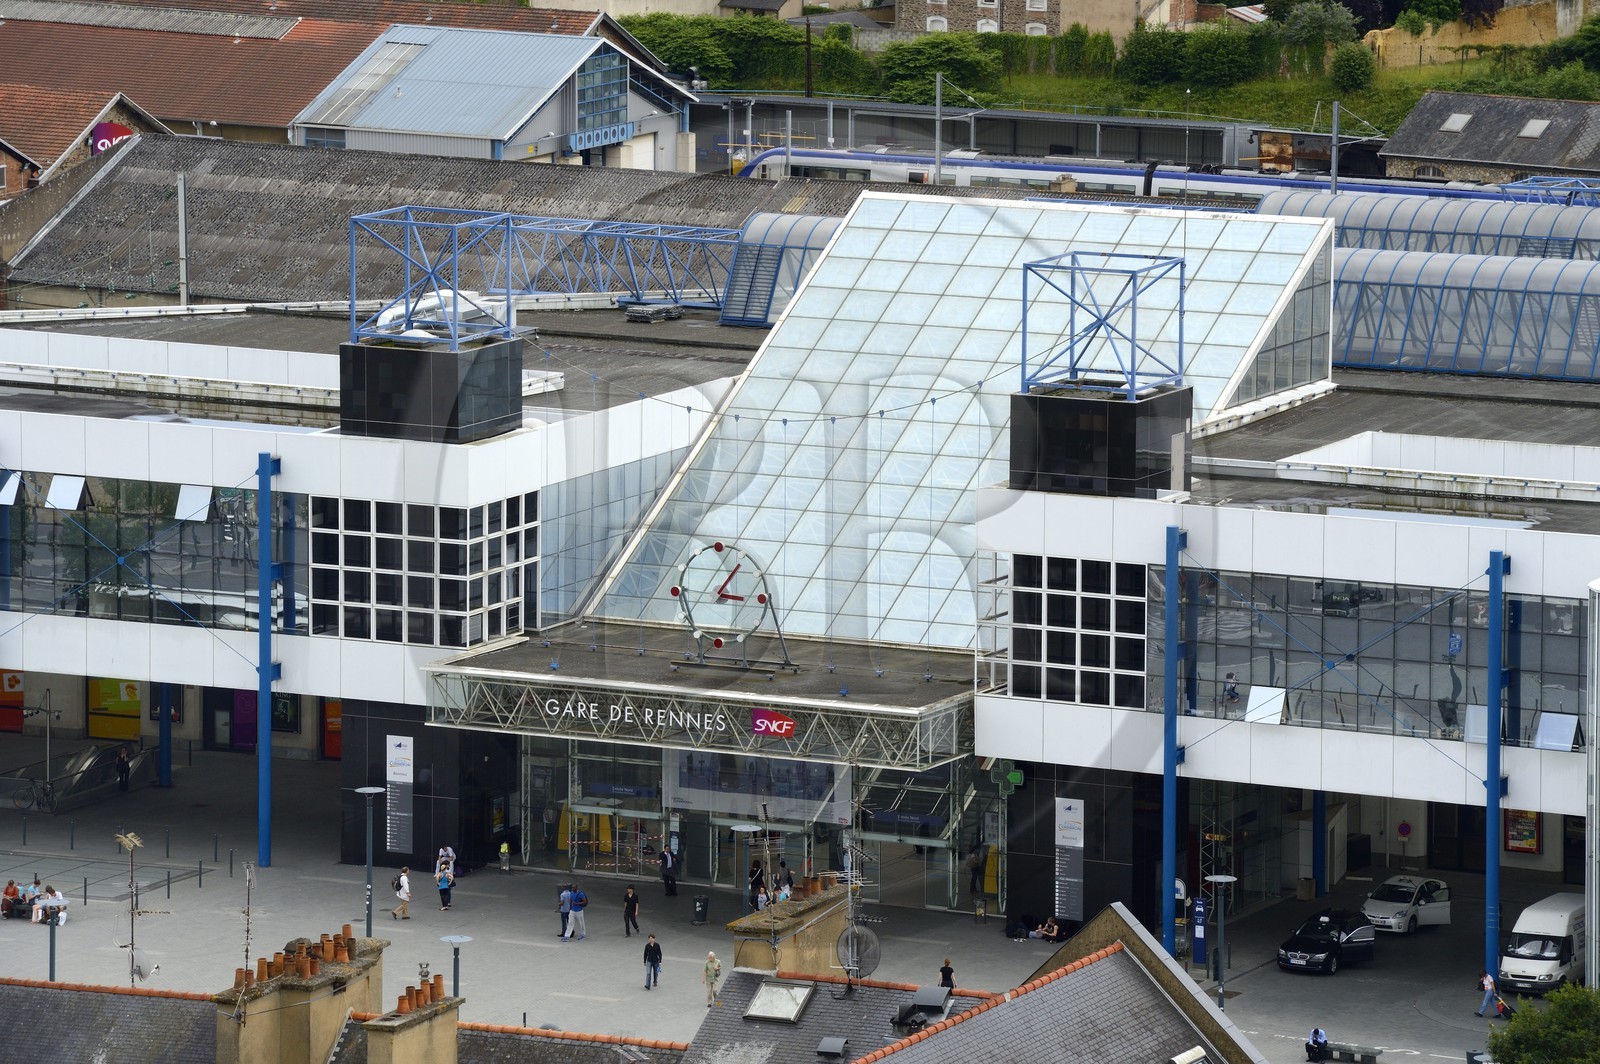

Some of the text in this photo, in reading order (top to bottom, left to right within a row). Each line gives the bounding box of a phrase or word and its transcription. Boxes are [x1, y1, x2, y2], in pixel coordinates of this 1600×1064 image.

[545, 699, 726, 731] GARE DE RENNES
[754, 718, 794, 733] SNCF
